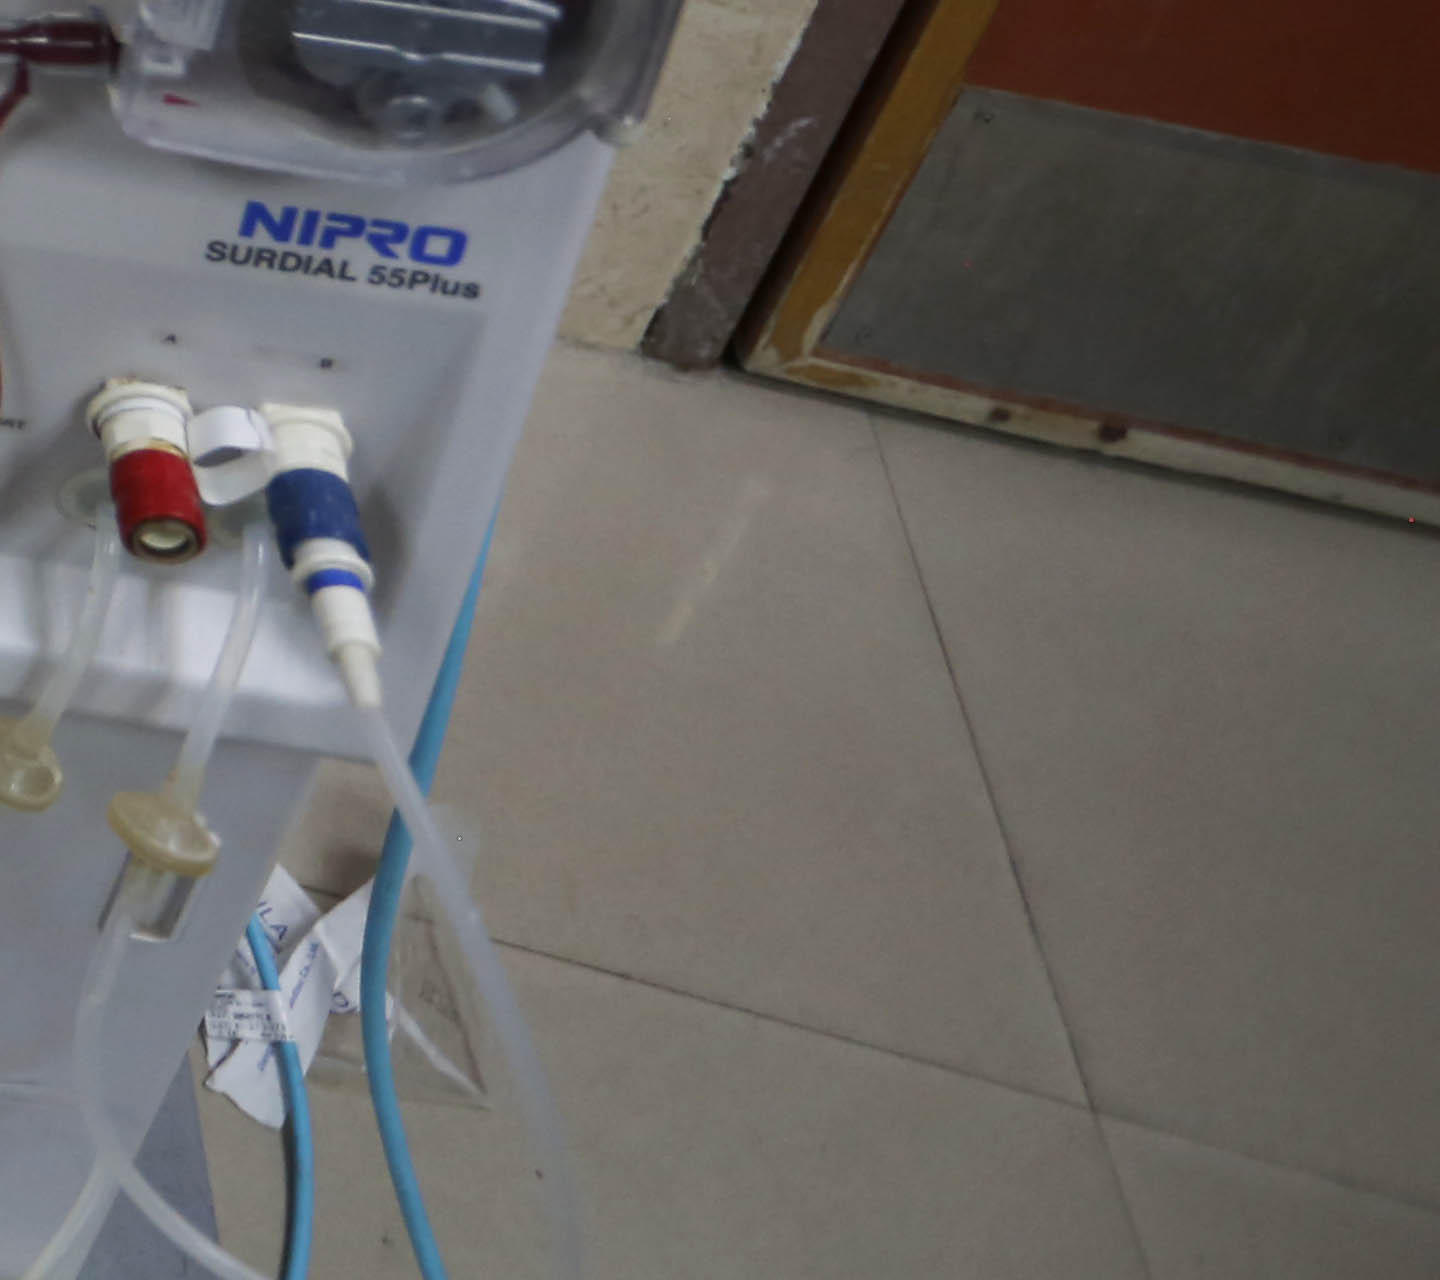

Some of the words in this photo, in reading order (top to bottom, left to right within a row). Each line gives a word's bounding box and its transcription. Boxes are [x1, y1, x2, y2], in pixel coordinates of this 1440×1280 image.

[238, 200, 470, 267] NIPRO
[204, 240, 358, 283] SURDIAL
[367, 264, 483, 301] 55Plus
